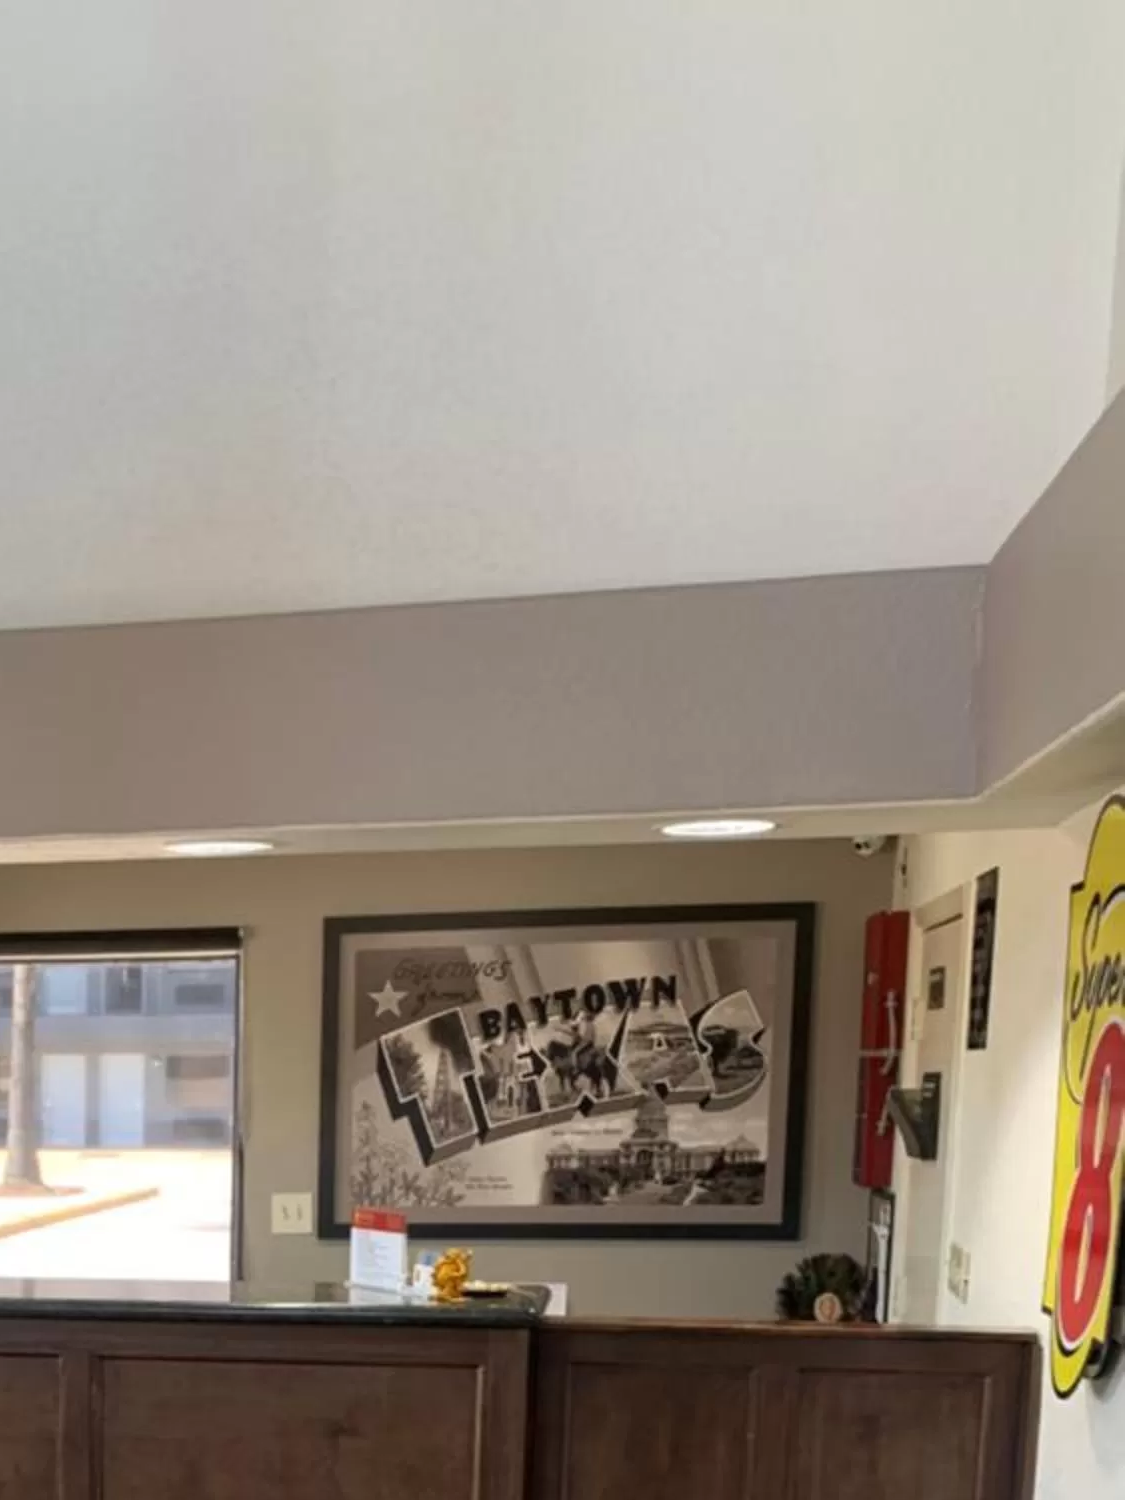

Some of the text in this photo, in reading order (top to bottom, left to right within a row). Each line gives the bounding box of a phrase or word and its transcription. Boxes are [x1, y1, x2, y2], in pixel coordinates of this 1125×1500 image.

[377, 988, 769, 1168] TEXAS
[478, 974, 678, 1040] BAYTOWN
[1058, 1016, 1125, 1357] 8
